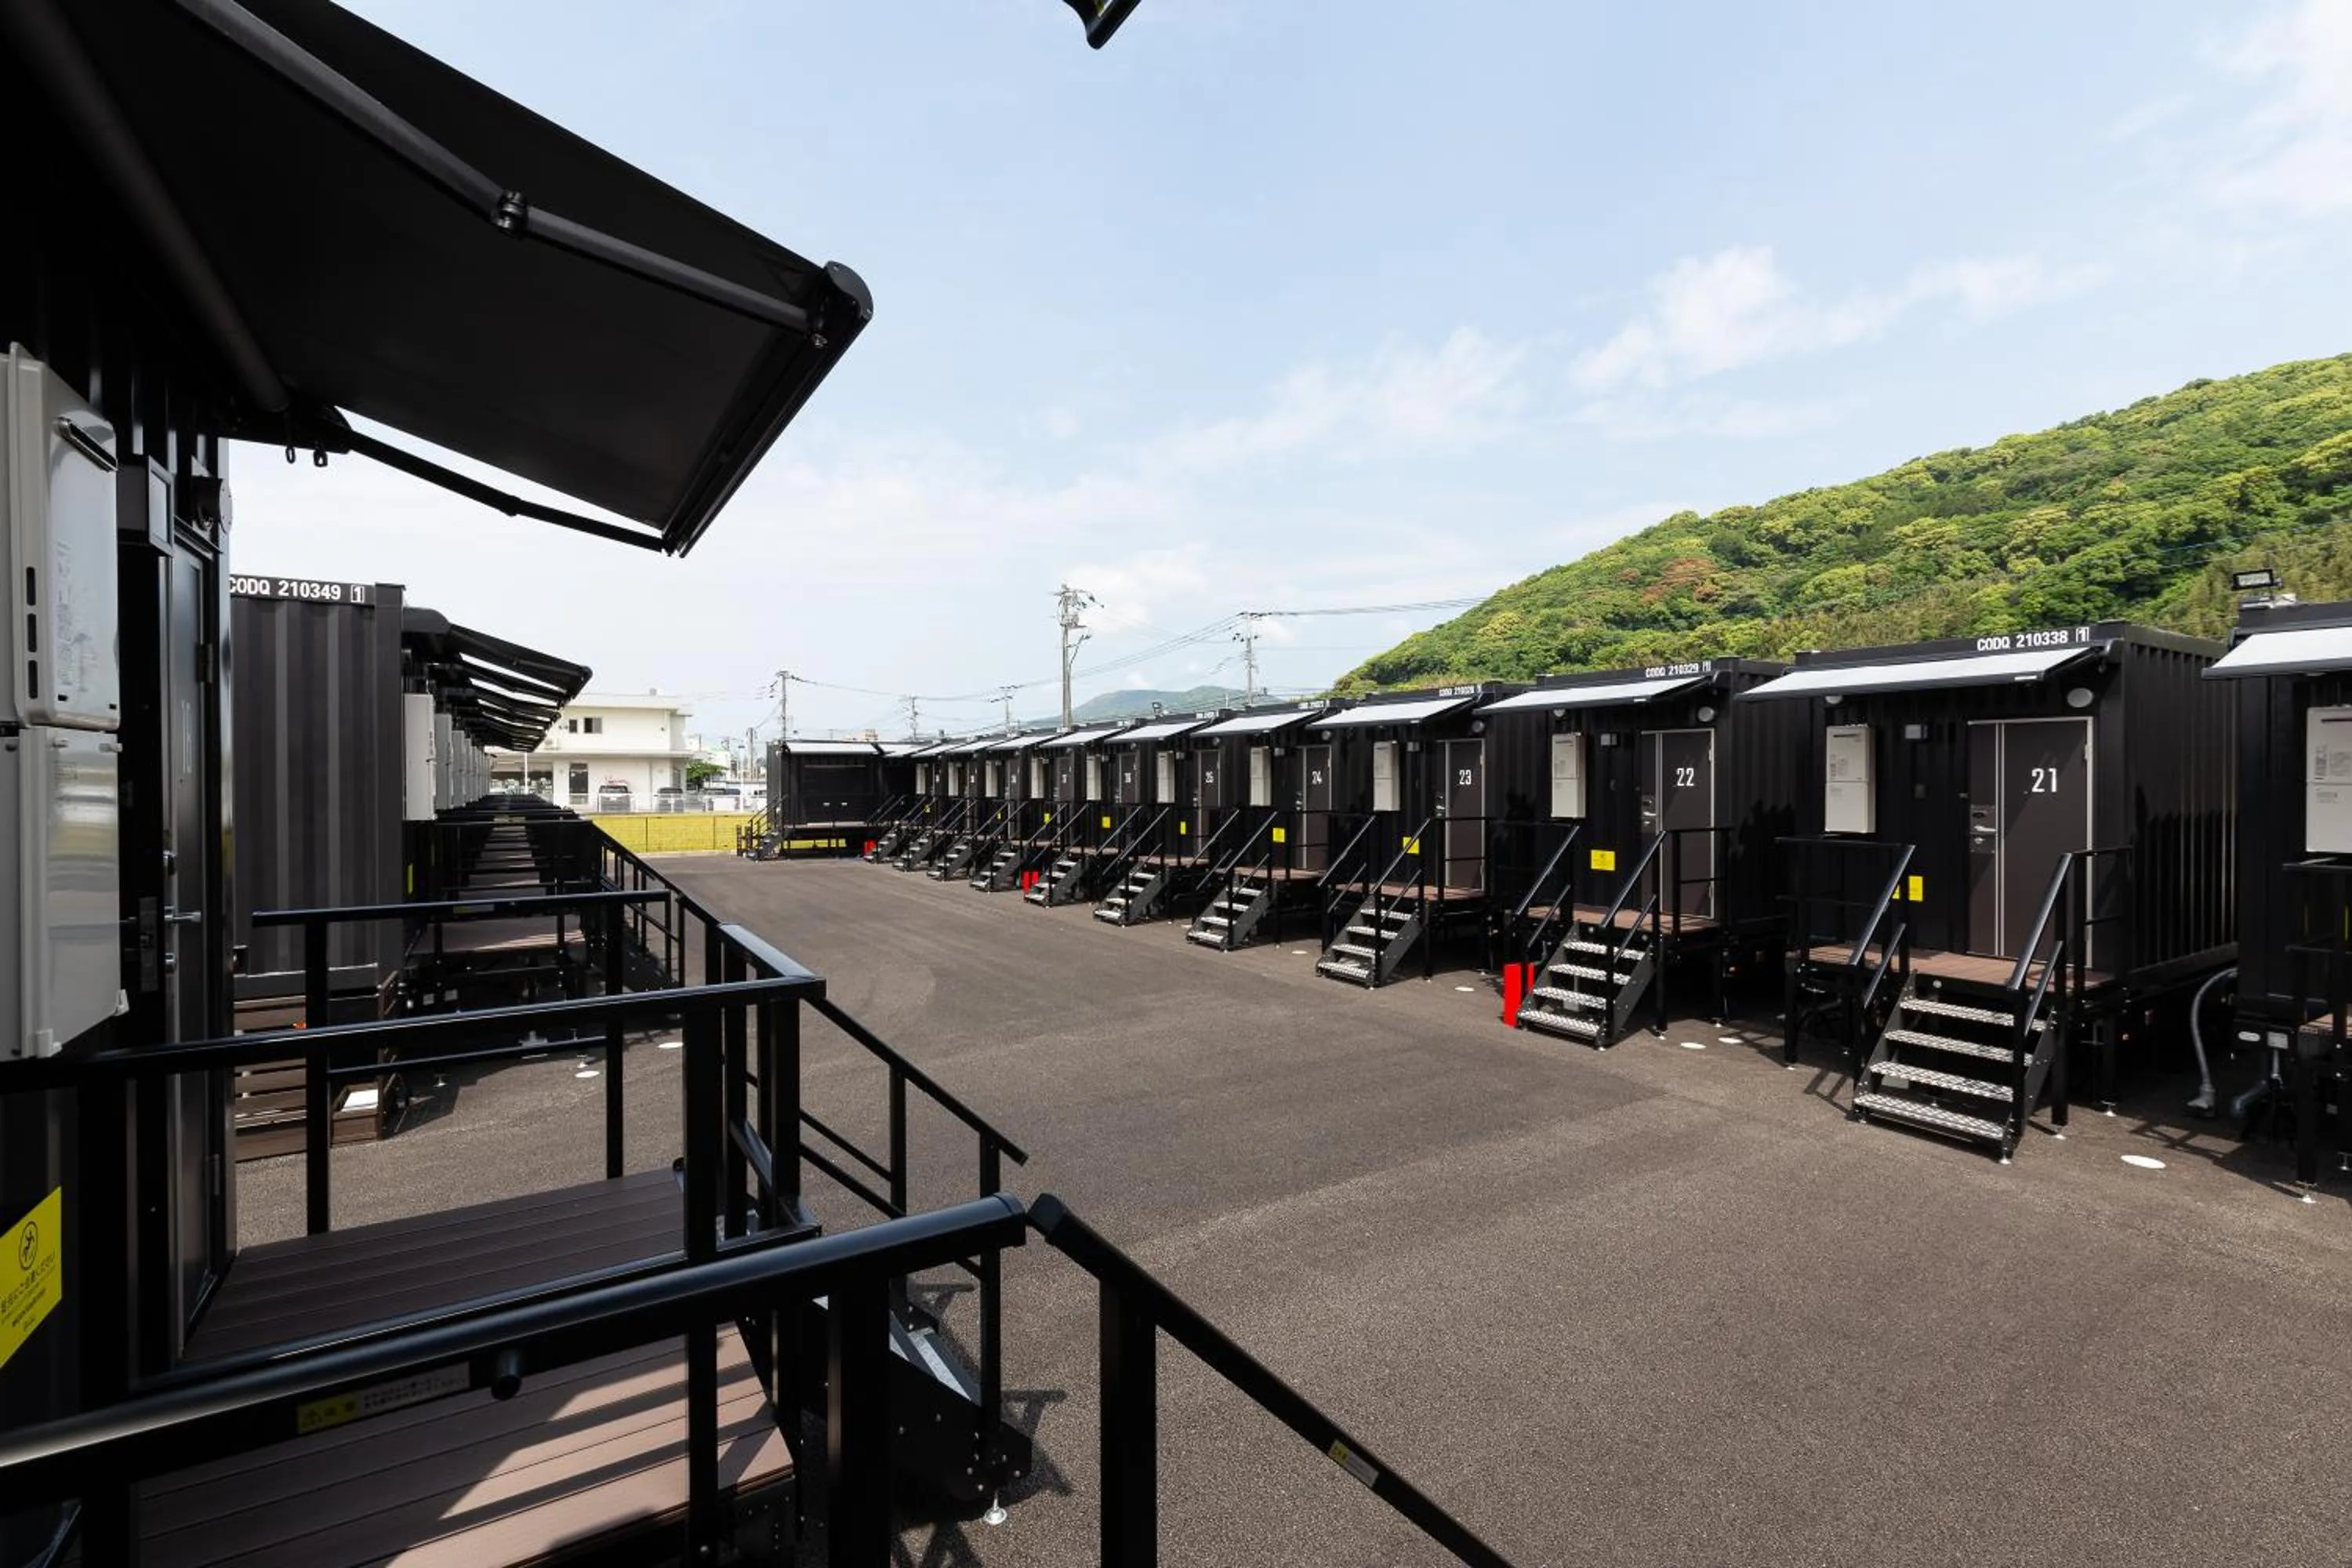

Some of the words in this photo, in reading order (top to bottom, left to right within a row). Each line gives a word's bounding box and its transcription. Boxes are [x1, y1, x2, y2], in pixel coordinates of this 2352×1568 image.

[230, 577, 270, 595] CODQ
[278, 580, 341, 600] 210349
[352, 586, 364, 602] 1
[1976, 636, 2011, 652] CODQ
[2016, 630, 2068, 648] 210338
[2077, 628, 2089, 642] 1
[1312, 771, 1323, 785] 24
[1459, 769, 1472, 785] 23
[1677, 768, 1694, 786] 22
[2031, 768, 2057, 793] 21
